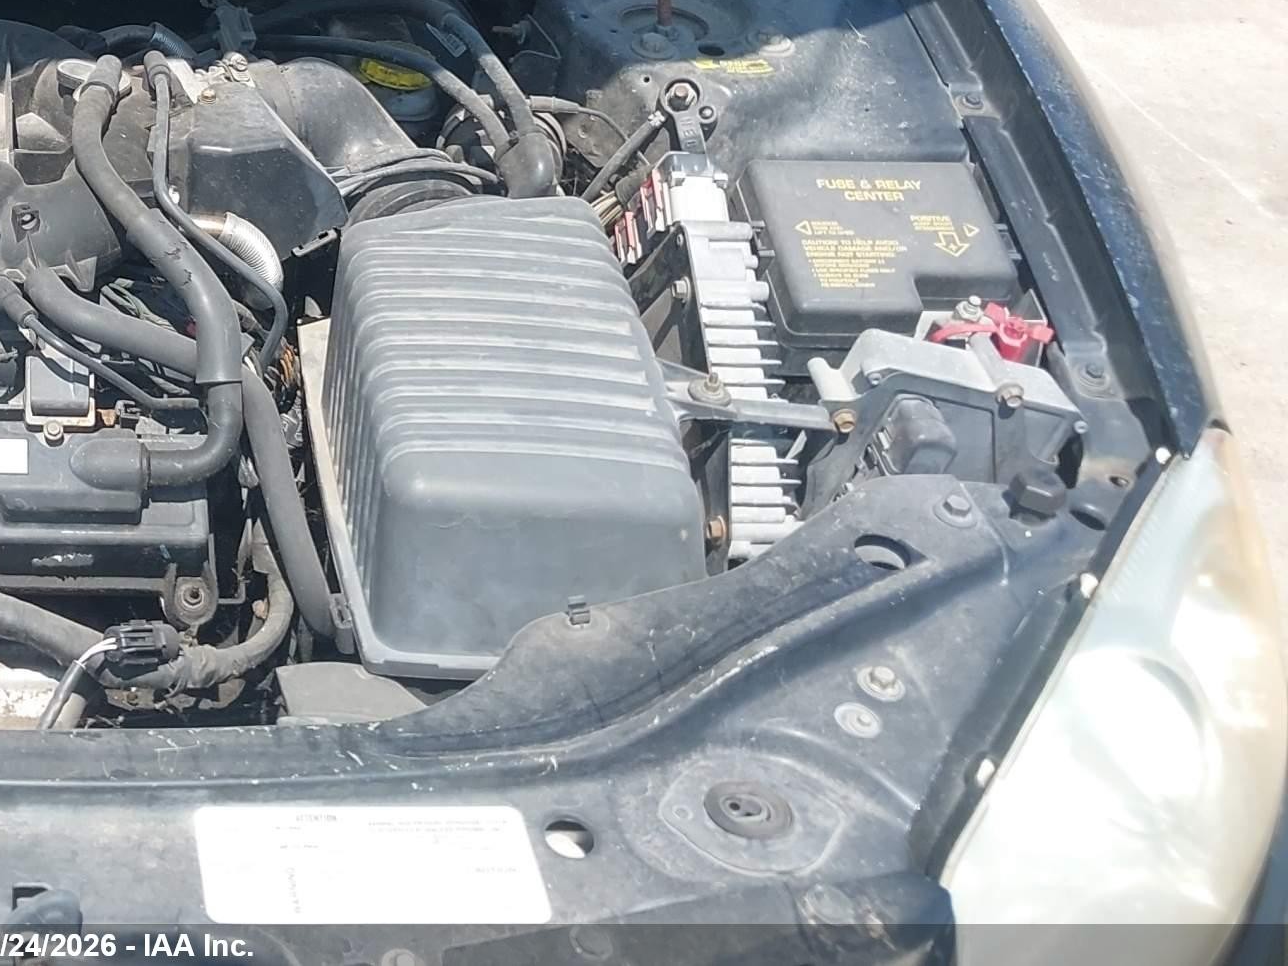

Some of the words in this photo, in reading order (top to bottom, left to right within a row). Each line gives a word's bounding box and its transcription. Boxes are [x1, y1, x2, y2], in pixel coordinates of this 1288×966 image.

[815, 178, 856, 190] FUSE
[860, 178, 872, 190] &
[874, 179, 921, 191] RELAY
[843, 190, 905, 202] CENTER
